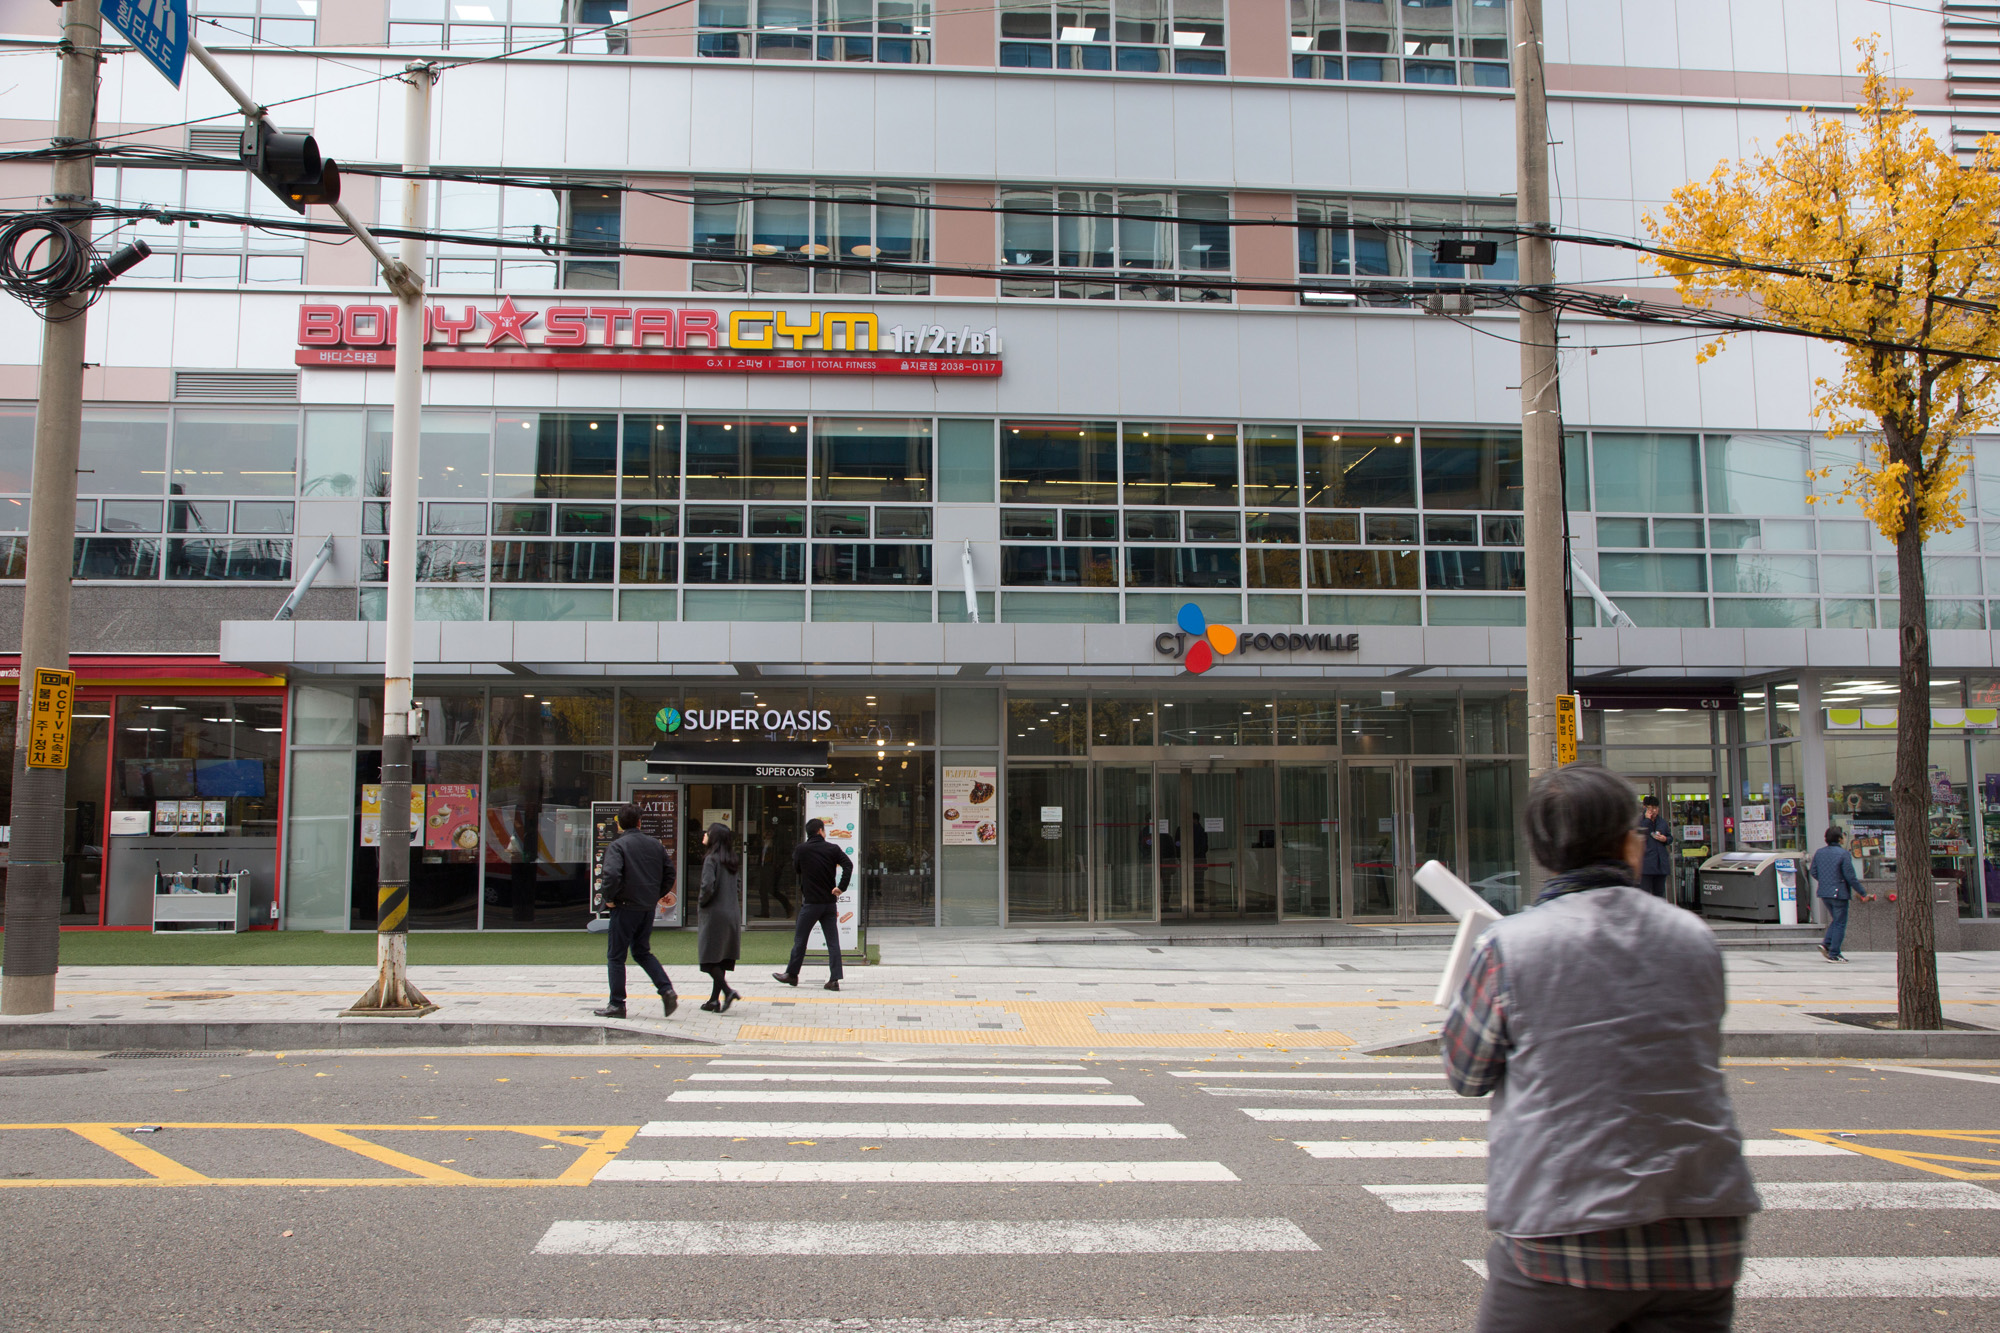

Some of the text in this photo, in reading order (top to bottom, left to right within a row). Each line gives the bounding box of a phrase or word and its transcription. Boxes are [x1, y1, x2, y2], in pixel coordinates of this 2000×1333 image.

[544, 306, 719, 349] STAR
[729, 310, 879, 352] GYM
[319, 352, 377, 363] 바디스타짐
[817, 361, 843, 369] TOTAL
[846, 361, 877, 369] FITNESS
[940, 362, 996, 372] 2038-0117
[1155, 632, 1360, 659] CJ FOODVILLE
[38, 688, 51, 712] 불법
[684, 709, 832, 731] SUPER OASIS
[755, 767, 815, 777] SUPER OASIS
